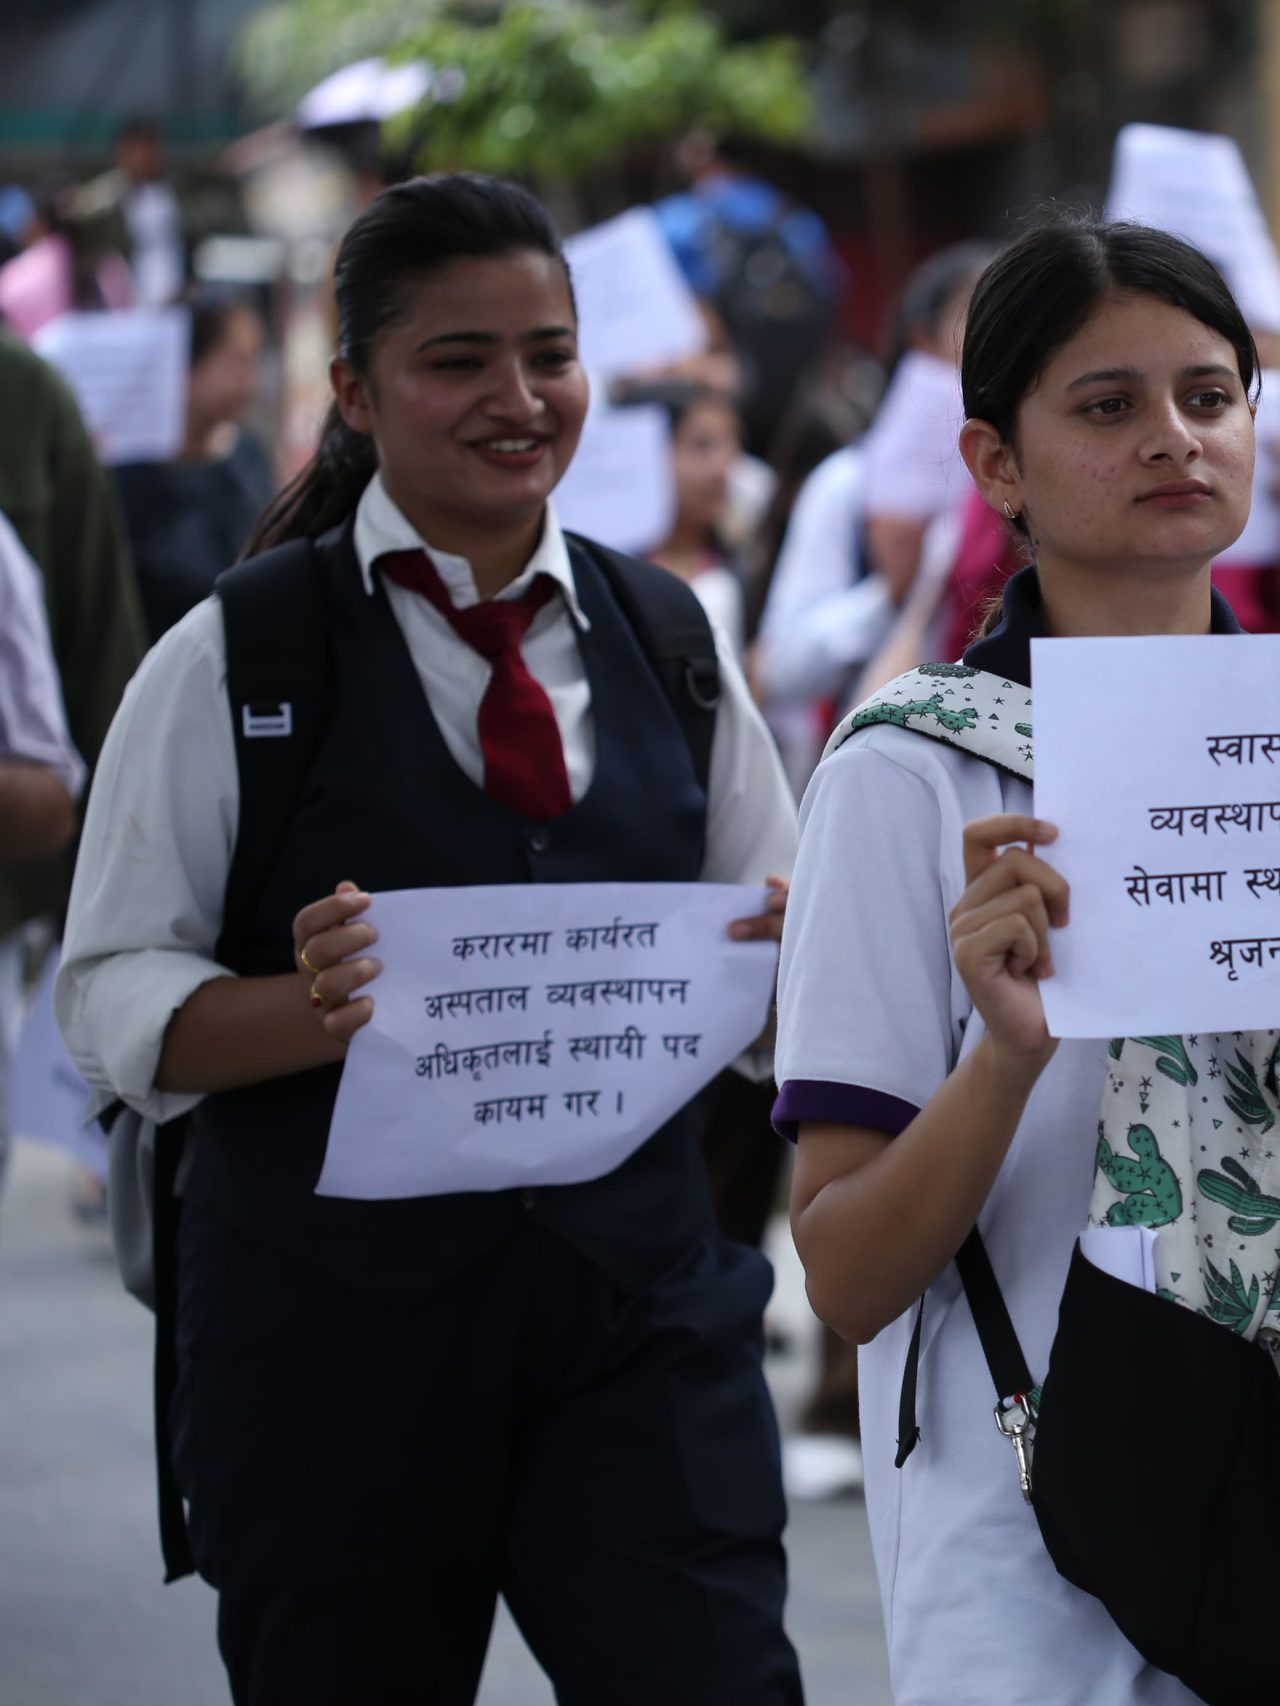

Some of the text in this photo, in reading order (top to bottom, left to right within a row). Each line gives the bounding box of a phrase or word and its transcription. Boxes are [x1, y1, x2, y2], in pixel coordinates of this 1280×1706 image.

[1123, 864, 1228, 907] सेवामा
[450, 915, 661, 963] करारमा कार्यरत
[423, 977, 691, 1022] अस्पताल व्यवस्थापन
[414, 1023, 703, 1083] अधिकृतलाई स्थायी पद
[472, 1091, 549, 1127] कायम
[562, 1089, 603, 1118] गर
